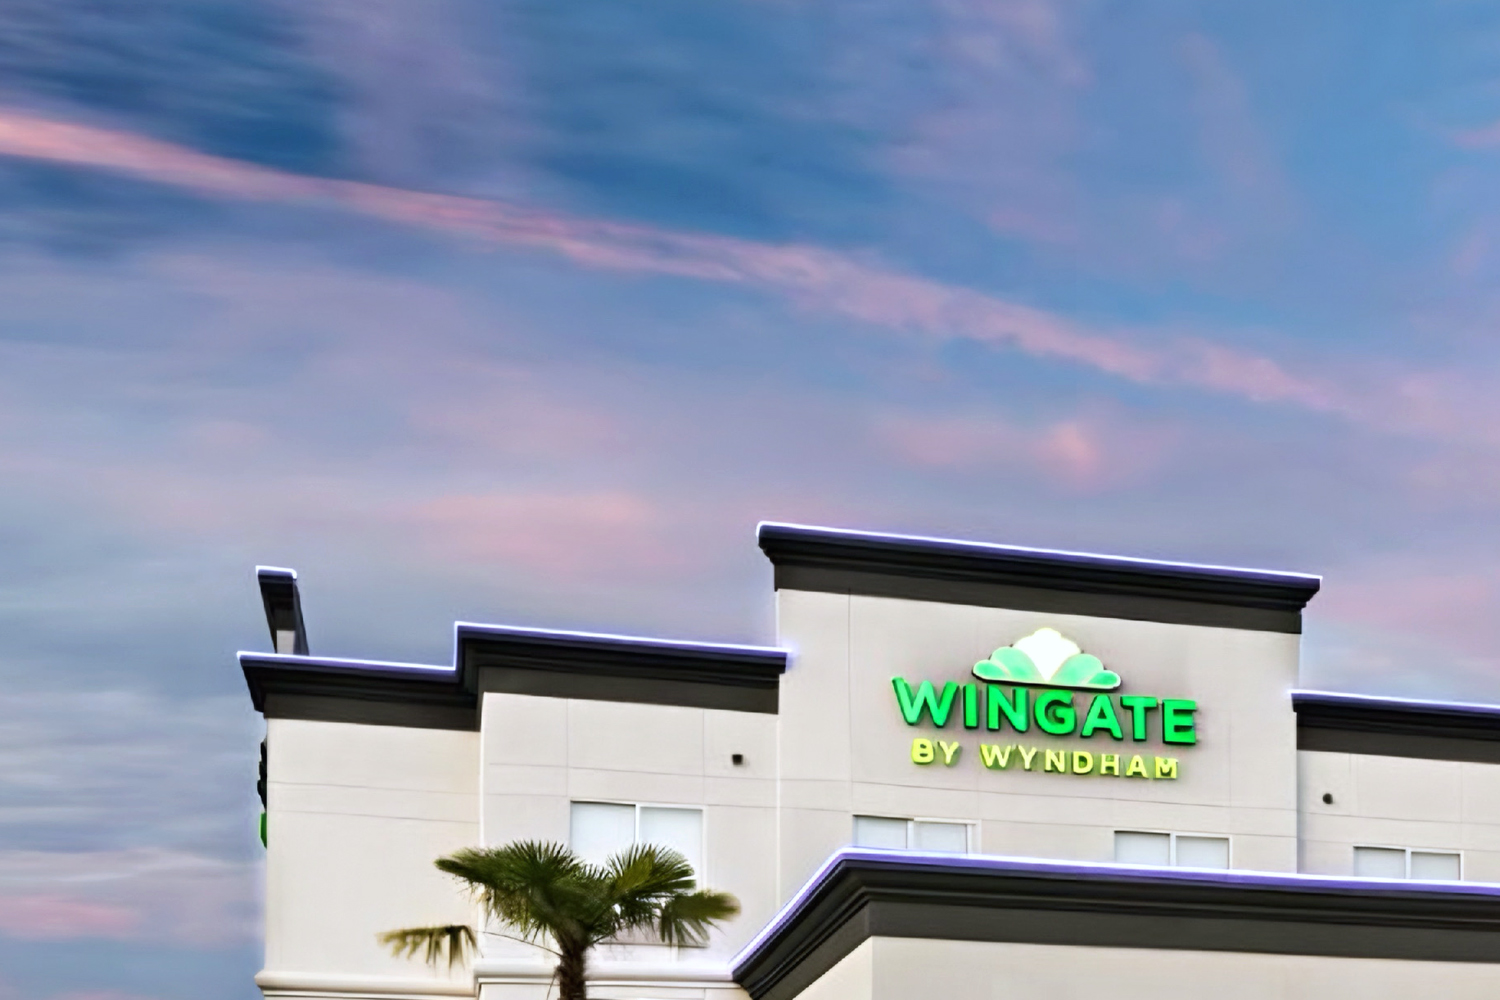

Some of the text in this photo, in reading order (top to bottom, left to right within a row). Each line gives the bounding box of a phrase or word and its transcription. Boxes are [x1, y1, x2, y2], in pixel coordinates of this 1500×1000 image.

[891, 676, 1198, 744] WINGATE
[911, 738, 1179, 780] BY WYNDHAM
